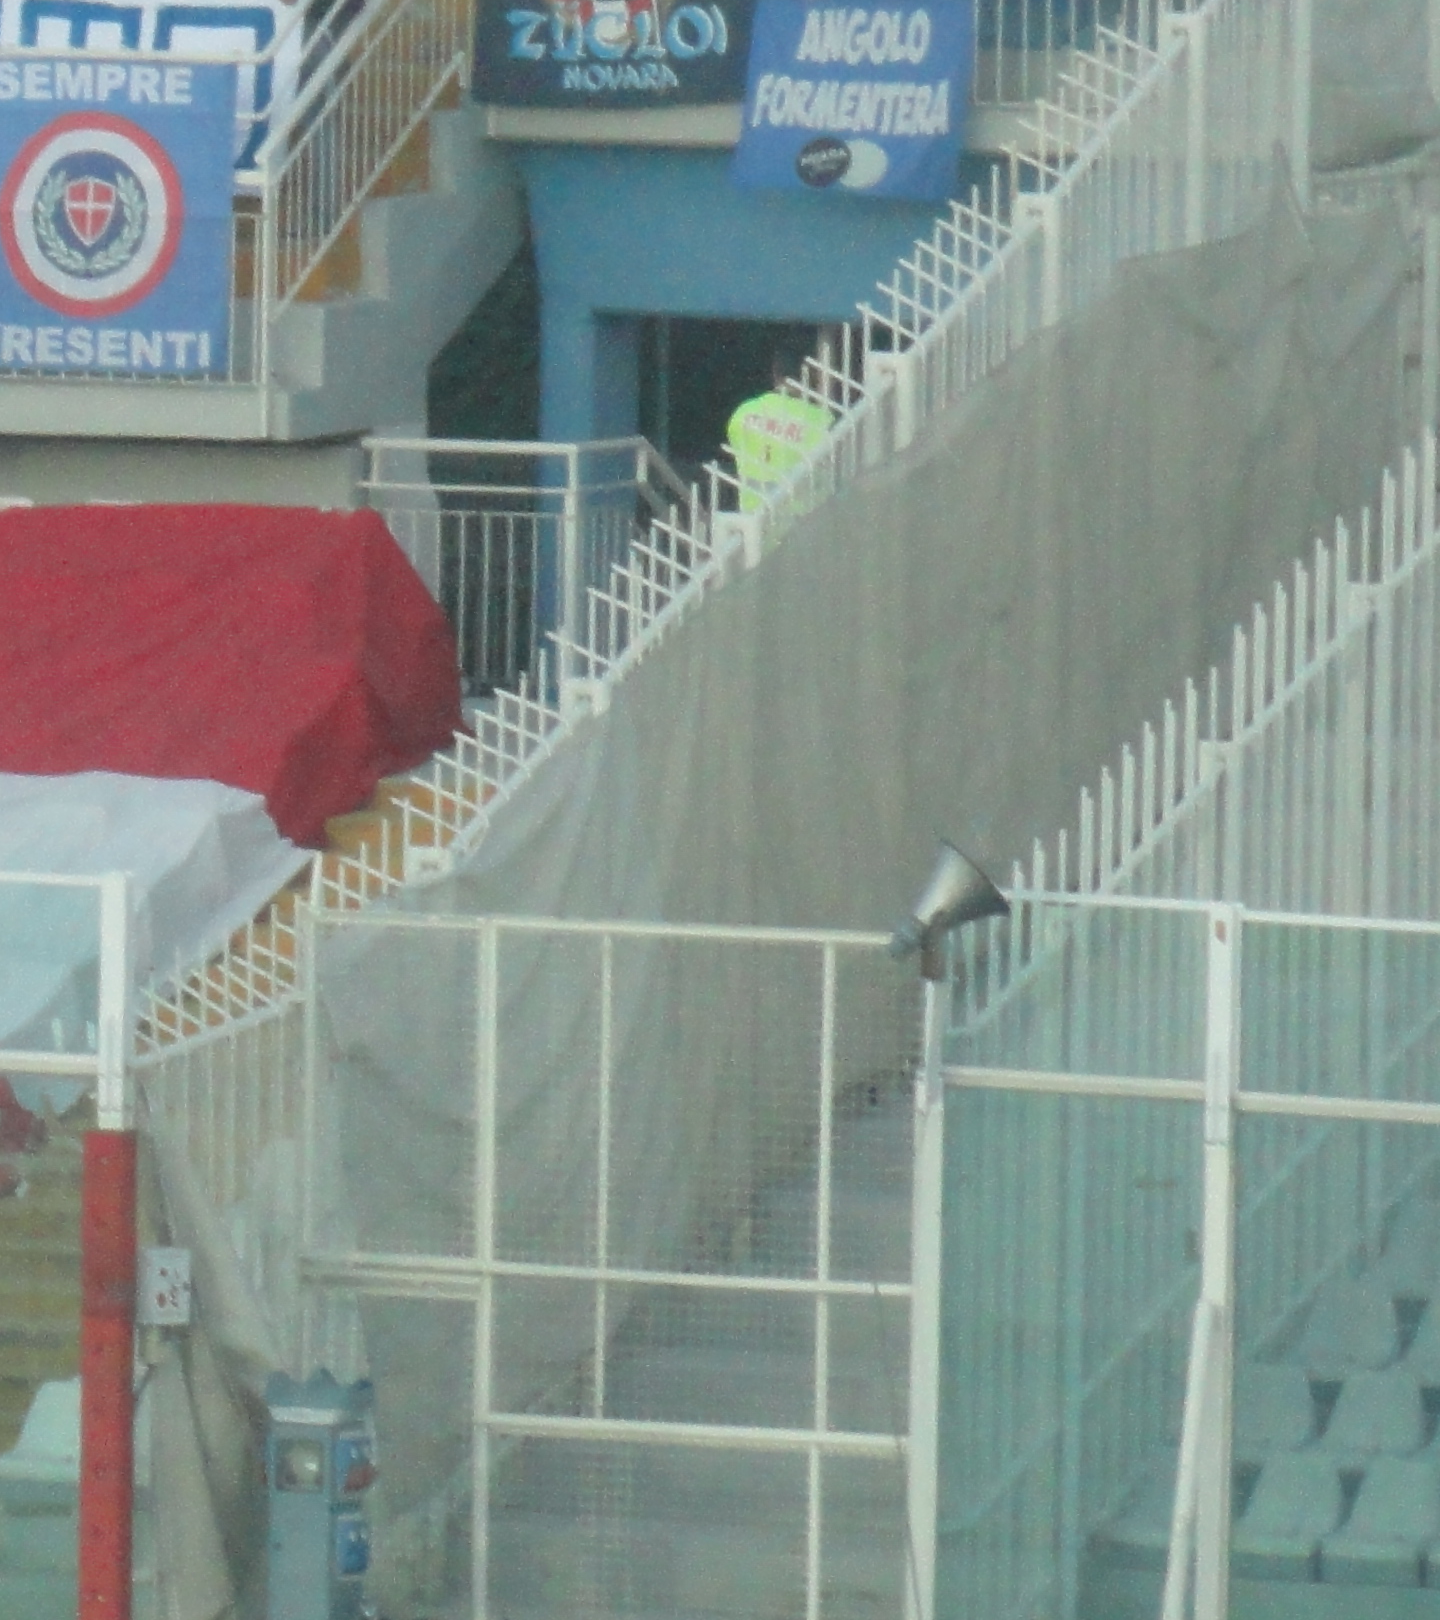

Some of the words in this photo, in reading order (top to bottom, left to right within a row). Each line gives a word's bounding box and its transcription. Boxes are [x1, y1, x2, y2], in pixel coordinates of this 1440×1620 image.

[796, 8, 931, 66] ANGOLO
[562, 63, 680, 92] NOVARA
[751, 72, 950, 137] FORMENTERA
